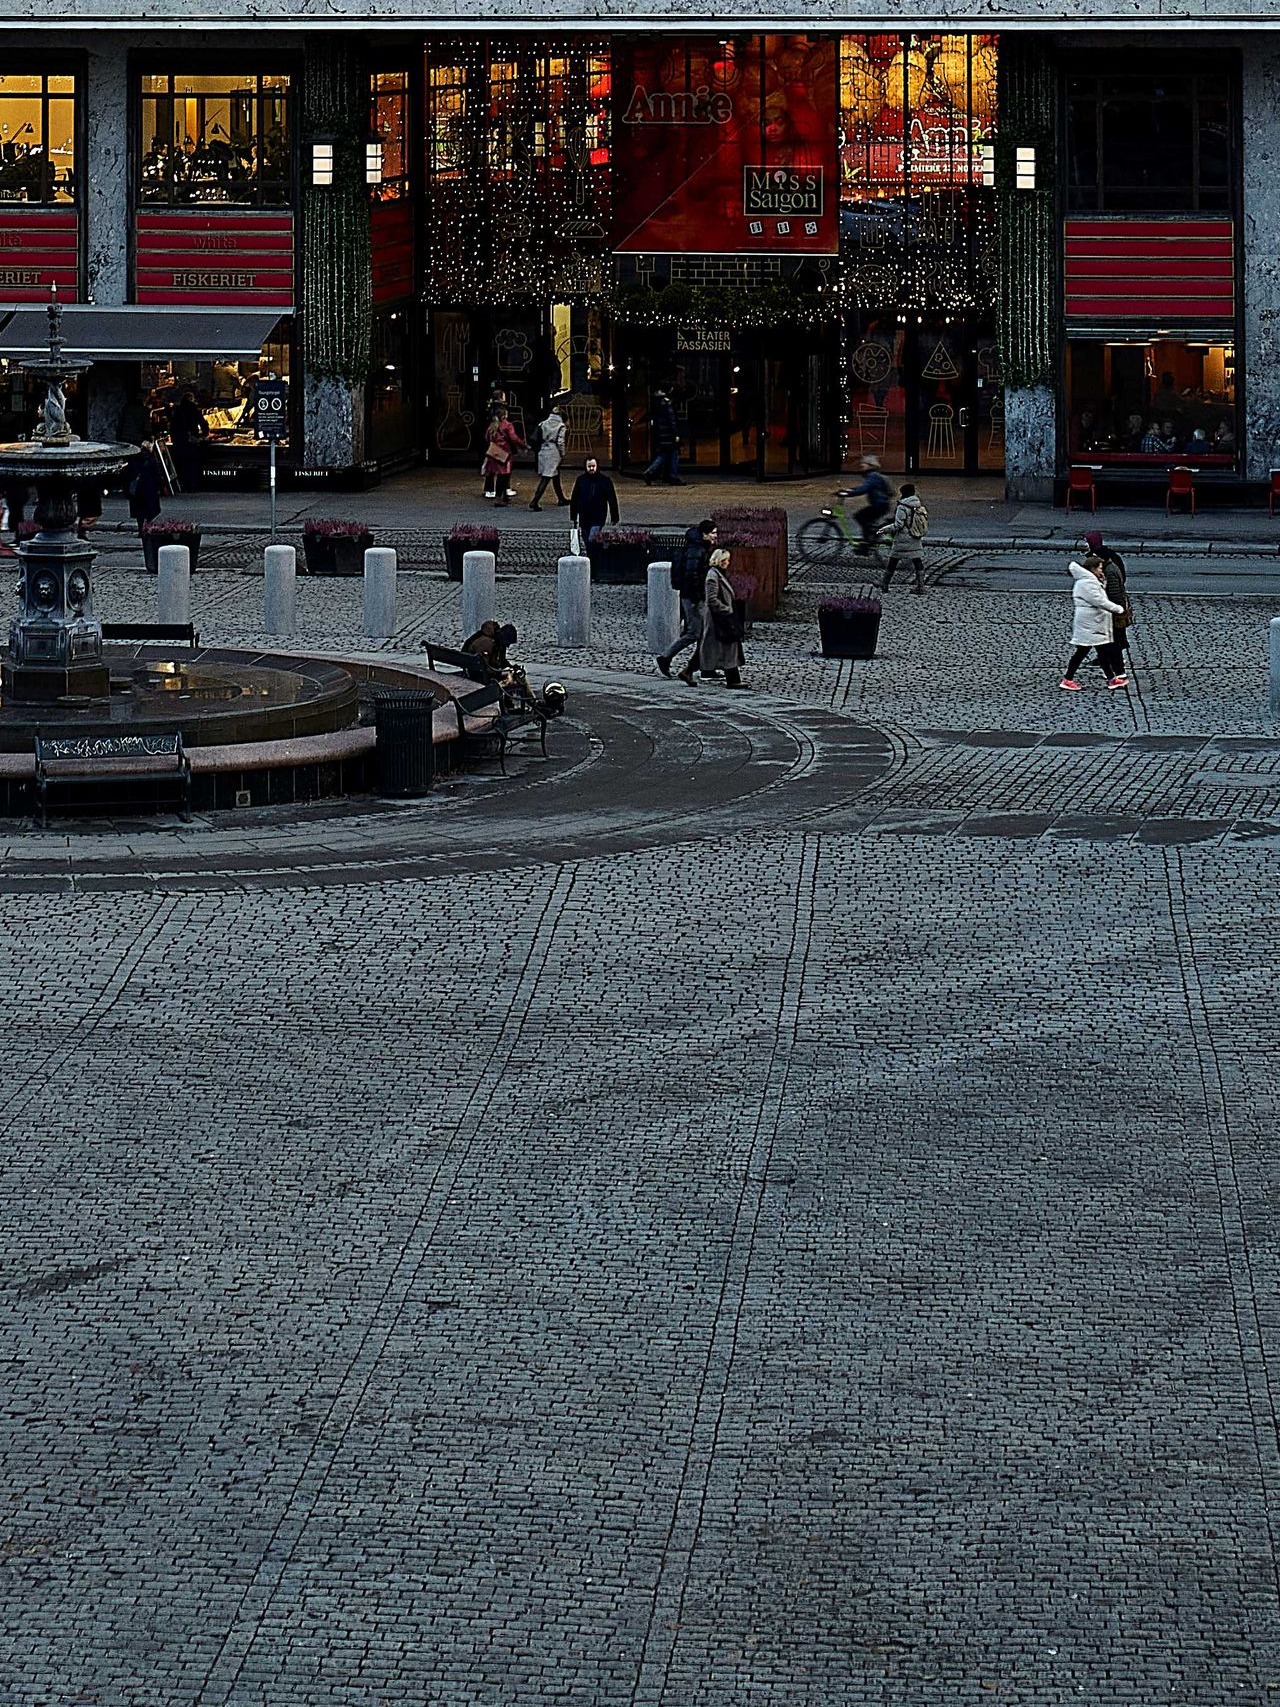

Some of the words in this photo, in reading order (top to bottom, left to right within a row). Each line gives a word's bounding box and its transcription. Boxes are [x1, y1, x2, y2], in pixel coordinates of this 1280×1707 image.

[620, 85, 730, 124] Annie
[747, 191, 815, 214] Saigon
[172, 273, 256, 286] FISKERIET
[696, 331, 731, 340] TEATER
